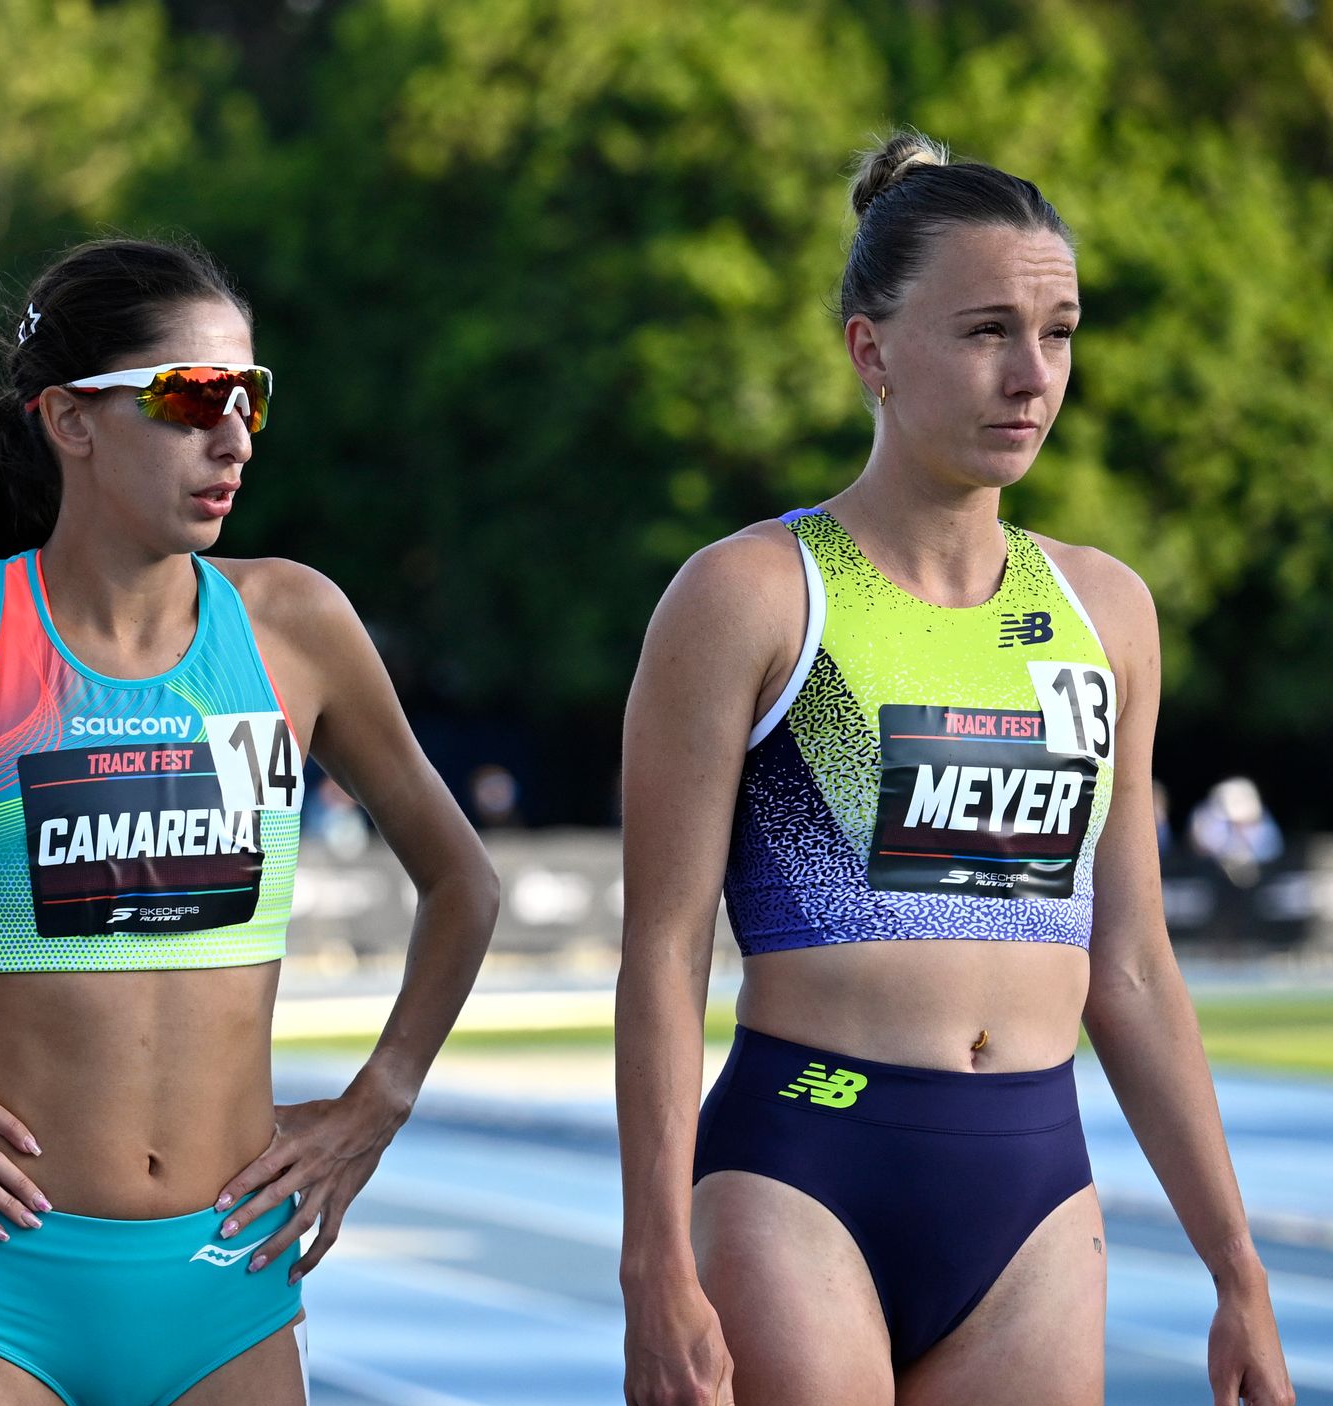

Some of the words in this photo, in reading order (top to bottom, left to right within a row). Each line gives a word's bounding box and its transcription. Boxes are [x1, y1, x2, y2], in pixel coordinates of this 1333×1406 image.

[944, 713, 997, 736] TRACK
[1001, 716, 1042, 737] FEST
[1051, 668, 1111, 759] 13
[70, 715, 192, 738] saucony
[88, 752, 145, 774] TRACK
[151, 749, 193, 772] FEST
[228, 719, 297, 807] 14
[903, 764, 1083, 835] MEYER
[37, 808, 258, 866] CAMARENA
[975, 871, 1029, 882] SKECHERS
[139, 906, 199, 915] SKECHERS
